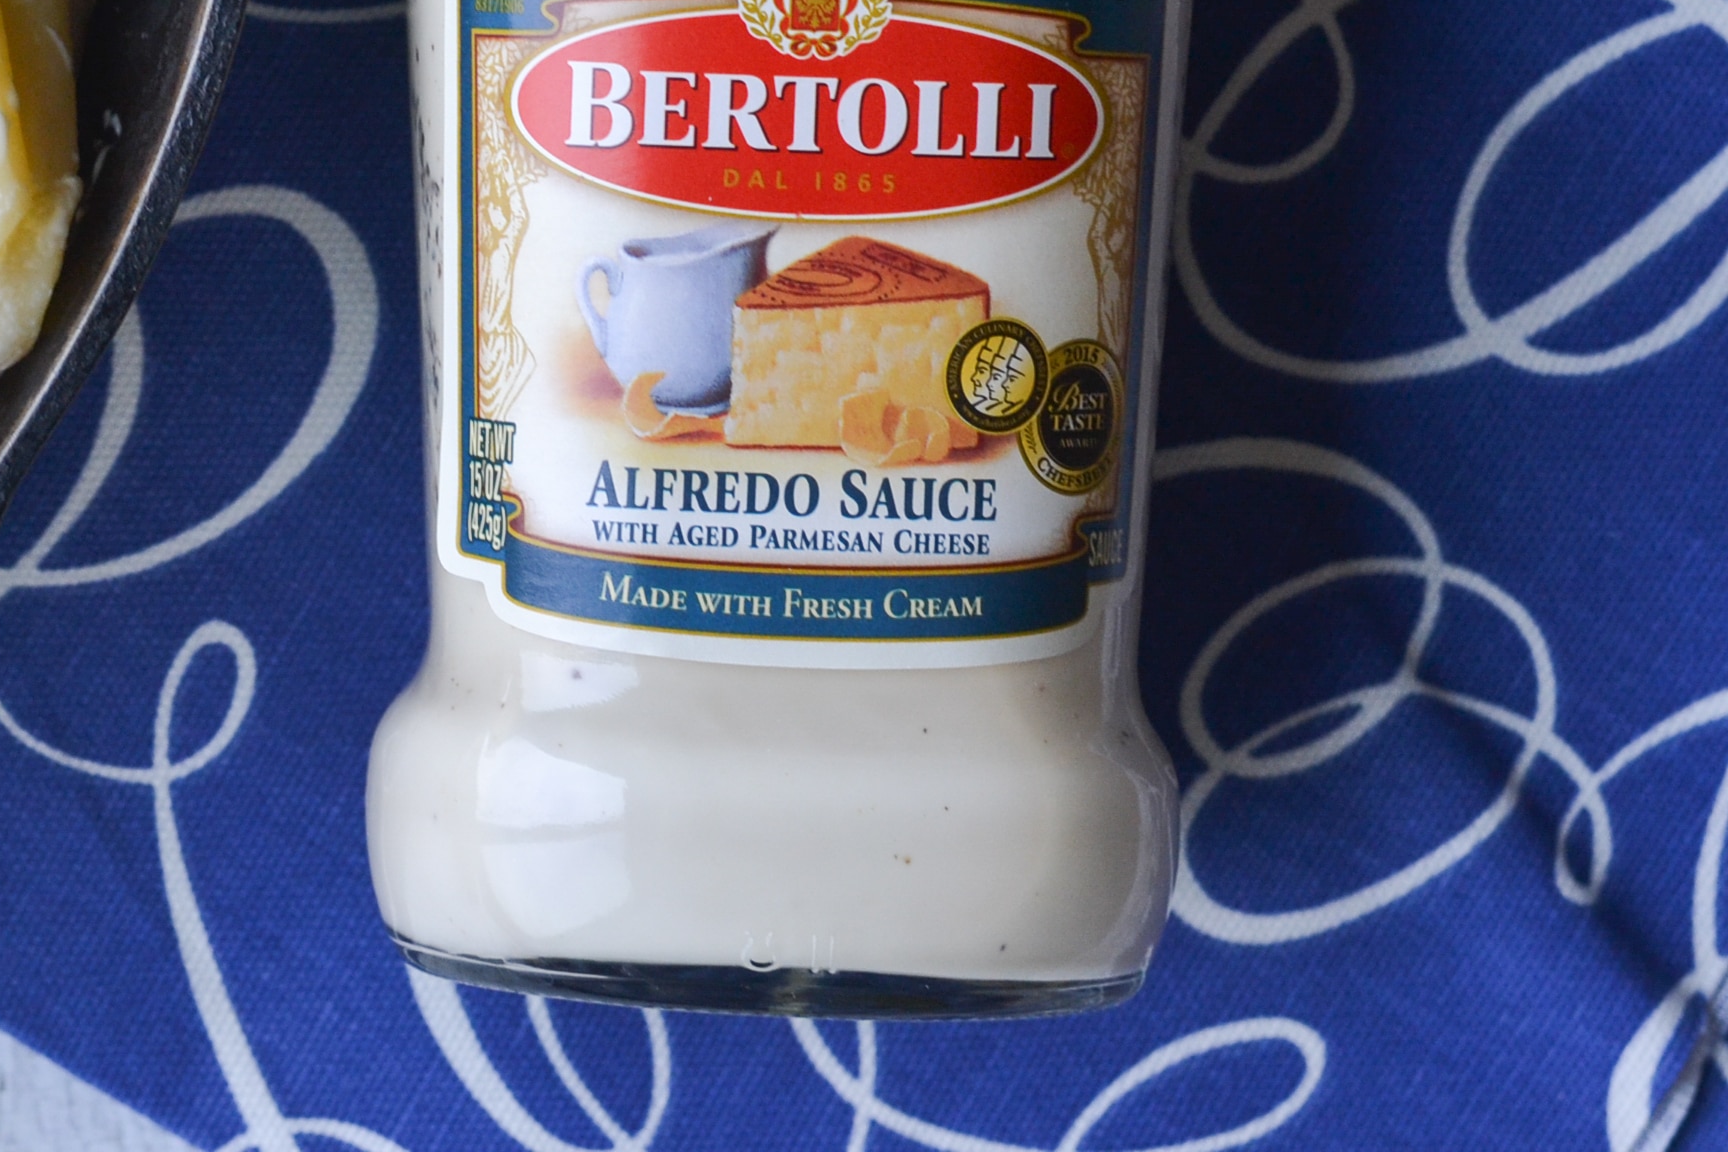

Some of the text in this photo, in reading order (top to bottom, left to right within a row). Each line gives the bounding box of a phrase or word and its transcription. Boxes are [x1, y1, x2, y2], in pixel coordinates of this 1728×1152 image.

[563, 59, 1059, 161] BERTOLLI
[722, 168, 897, 194] DAL 1865
[1063, 345, 1101, 364] 2015
[1047, 379, 1109, 414] BEST
[468, 418, 515, 462] NET WT
[469, 460, 503, 502] 15 OZ
[585, 459, 998, 522] ALFREDO SAUCE
[467, 501, 508, 552] (425g)
[591, 519, 991, 556] WITH AGED PARMESAN CHEESE
[598, 570, 984, 620] MADE WITH FRESH CREAM
